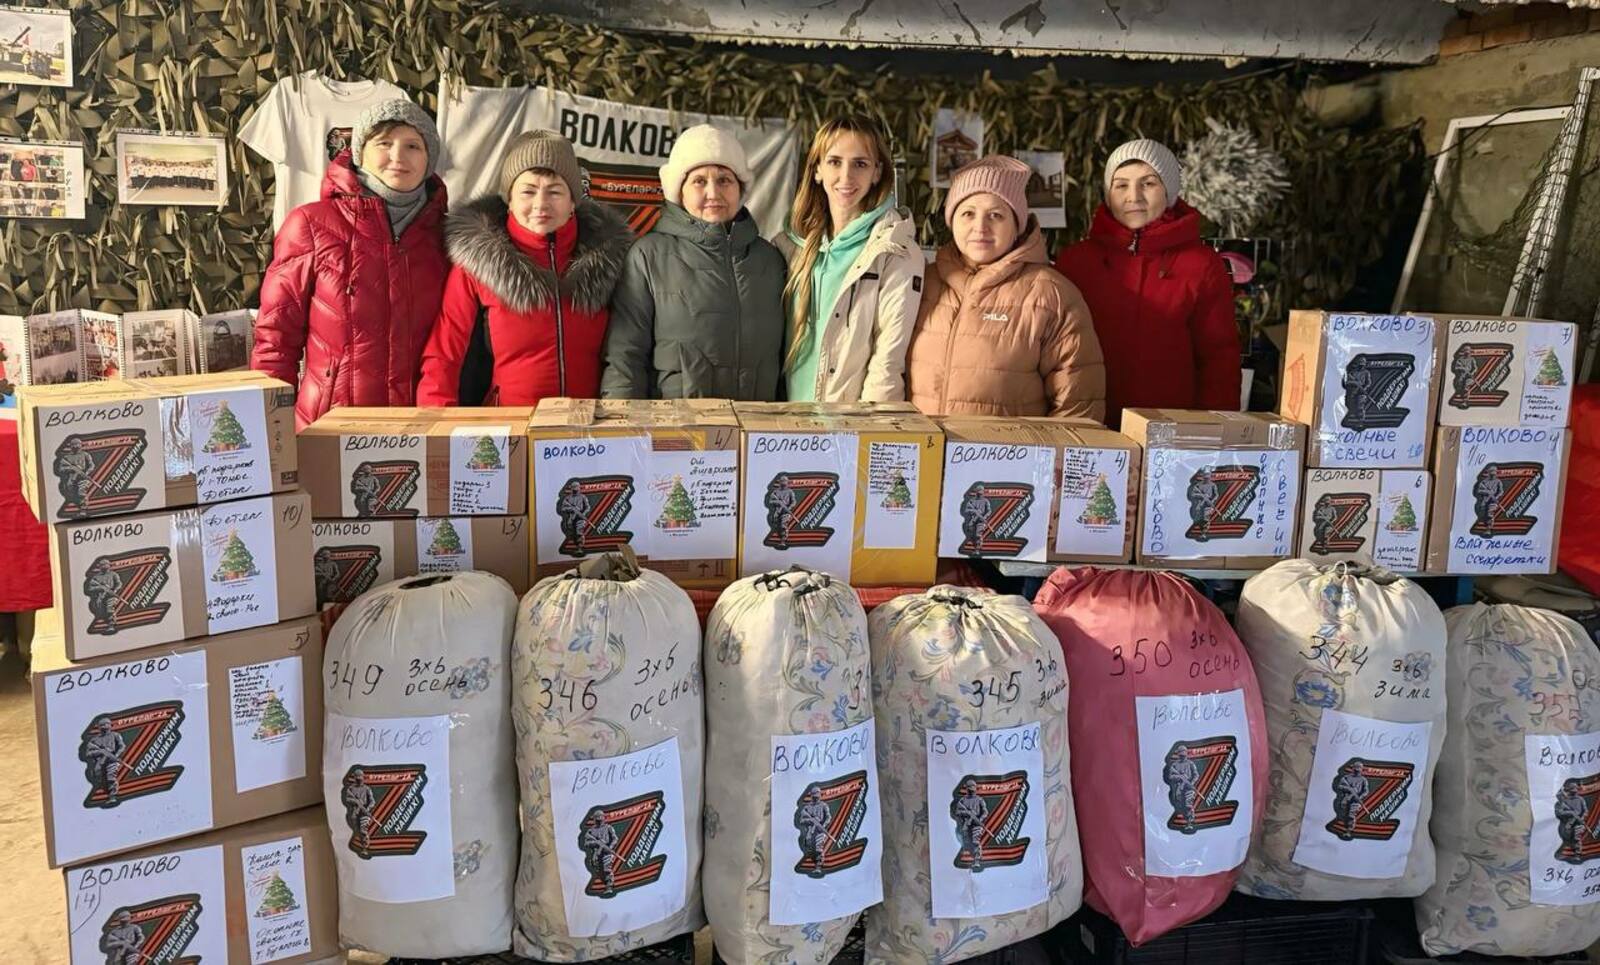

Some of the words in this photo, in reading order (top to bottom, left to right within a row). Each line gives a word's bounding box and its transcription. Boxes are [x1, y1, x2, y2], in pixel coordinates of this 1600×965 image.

[560, 108, 685, 158] ВОЛКОВ
[1333, 315, 1417, 332] ВОЛКОВО
[1452, 320, 1517, 335] ВОЛКОВО
[45, 402, 144, 428] ВОЛКОВО
[344, 435, 420, 451] ВОЛКОВО
[543, 443, 606, 460] ВОЛКОВО
[754, 436, 832, 454] ВОЛКОВО
[1463, 427, 1547, 444] ВОЛКОВО
[103, 440, 144, 494] ПОДДЕРЖИМ
[950, 445, 1028, 464] ВОЛКОВО
[1311, 470, 1375, 483] ВОЛКОВО
[72, 523, 143, 545] ВОЛКОВО
[311, 523, 371, 537] ОЛКОВО
[130, 556, 168, 609] ПОДДЕРЖИМ
[1110, 637, 1173, 677] 350
[1189, 654, 1241, 678] осень
[1299, 634, 1369, 674] 344
[55, 657, 170, 693] ВОЛКОВО
[329, 660, 384, 700] 349
[968, 670, 1022, 708] 345
[539, 677, 599, 713] 346
[134, 712, 181, 776] ПОДДЕРЖИМ
[148, 732, 177, 773] НАШИХ!
[341, 724, 433, 753] ВОЛКОВО
[772, 730, 870, 774] ВОЛКОВО
[383, 775, 423, 834] ПОДДЕРЖИМ
[78, 855, 181, 890] ВОЛКОВО
